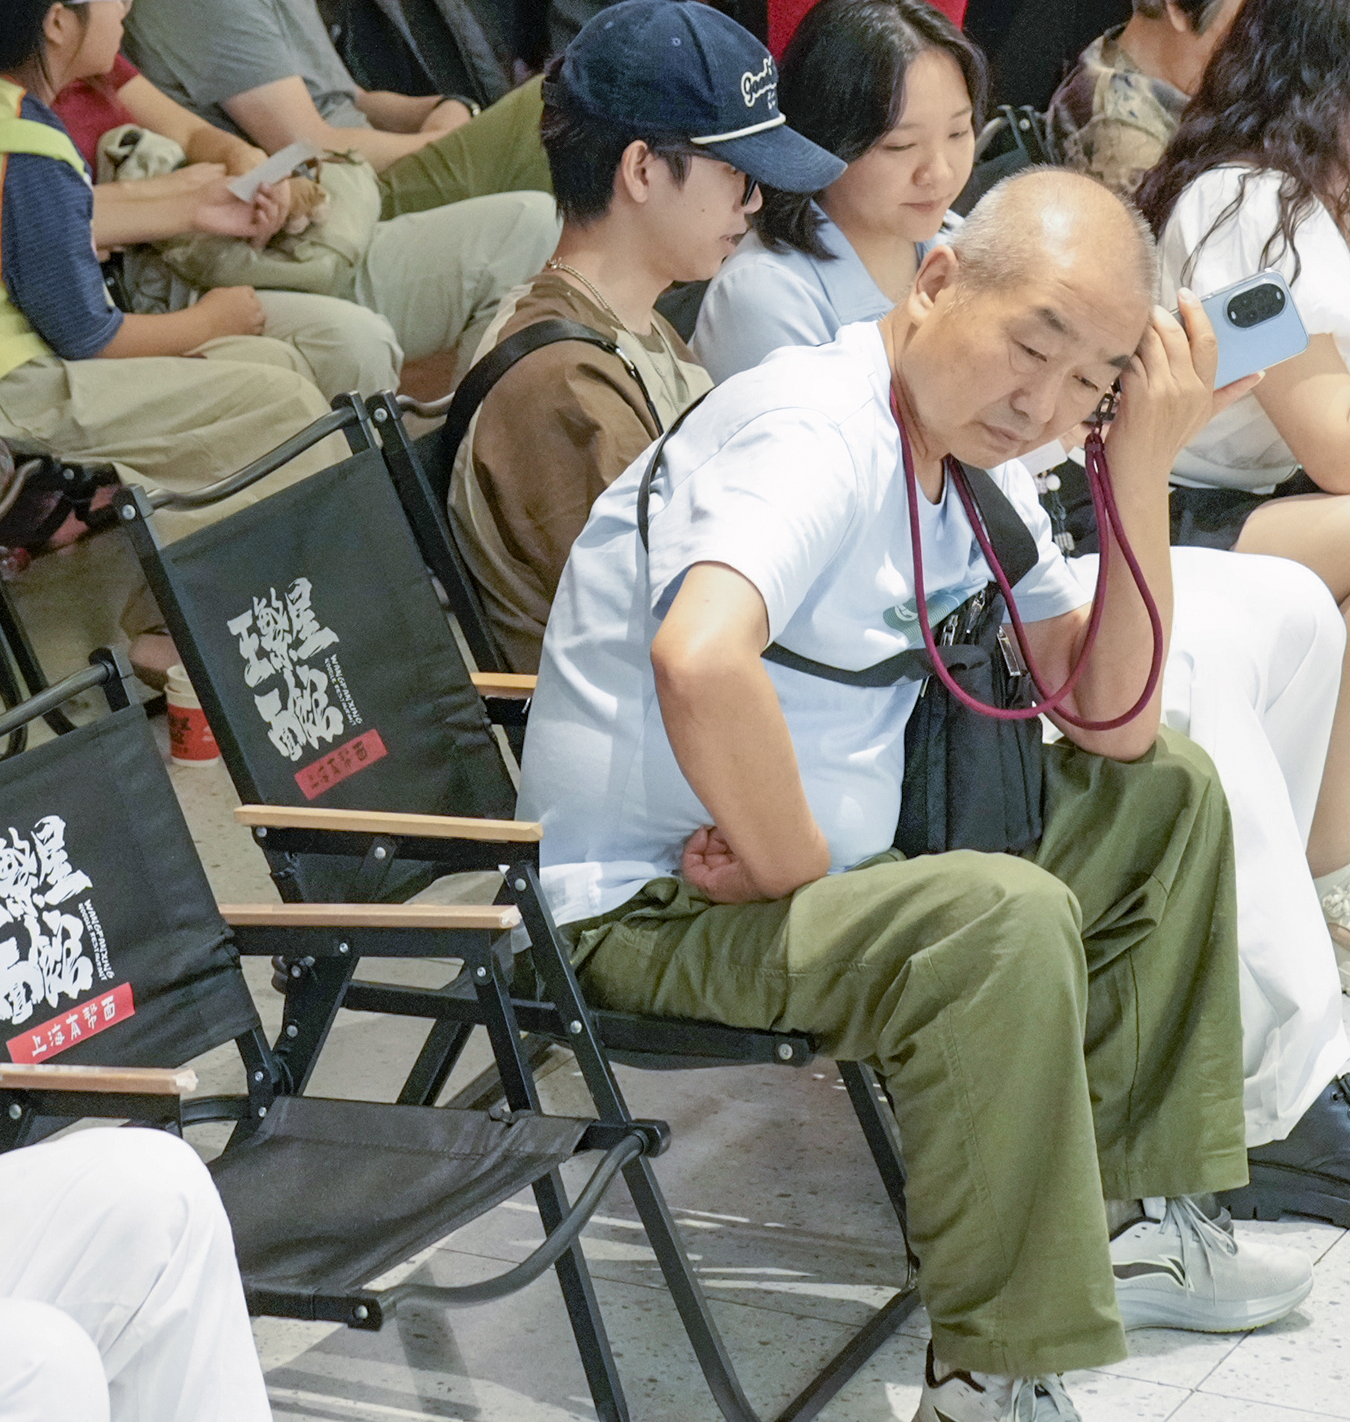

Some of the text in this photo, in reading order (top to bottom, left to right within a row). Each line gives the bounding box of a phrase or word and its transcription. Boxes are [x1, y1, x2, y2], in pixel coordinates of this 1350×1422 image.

[77, 902, 94, 932] NOODLE
[83, 898, 116, 980] WANGFANXING
[31, 994, 116, 1057] 上海本帮面
